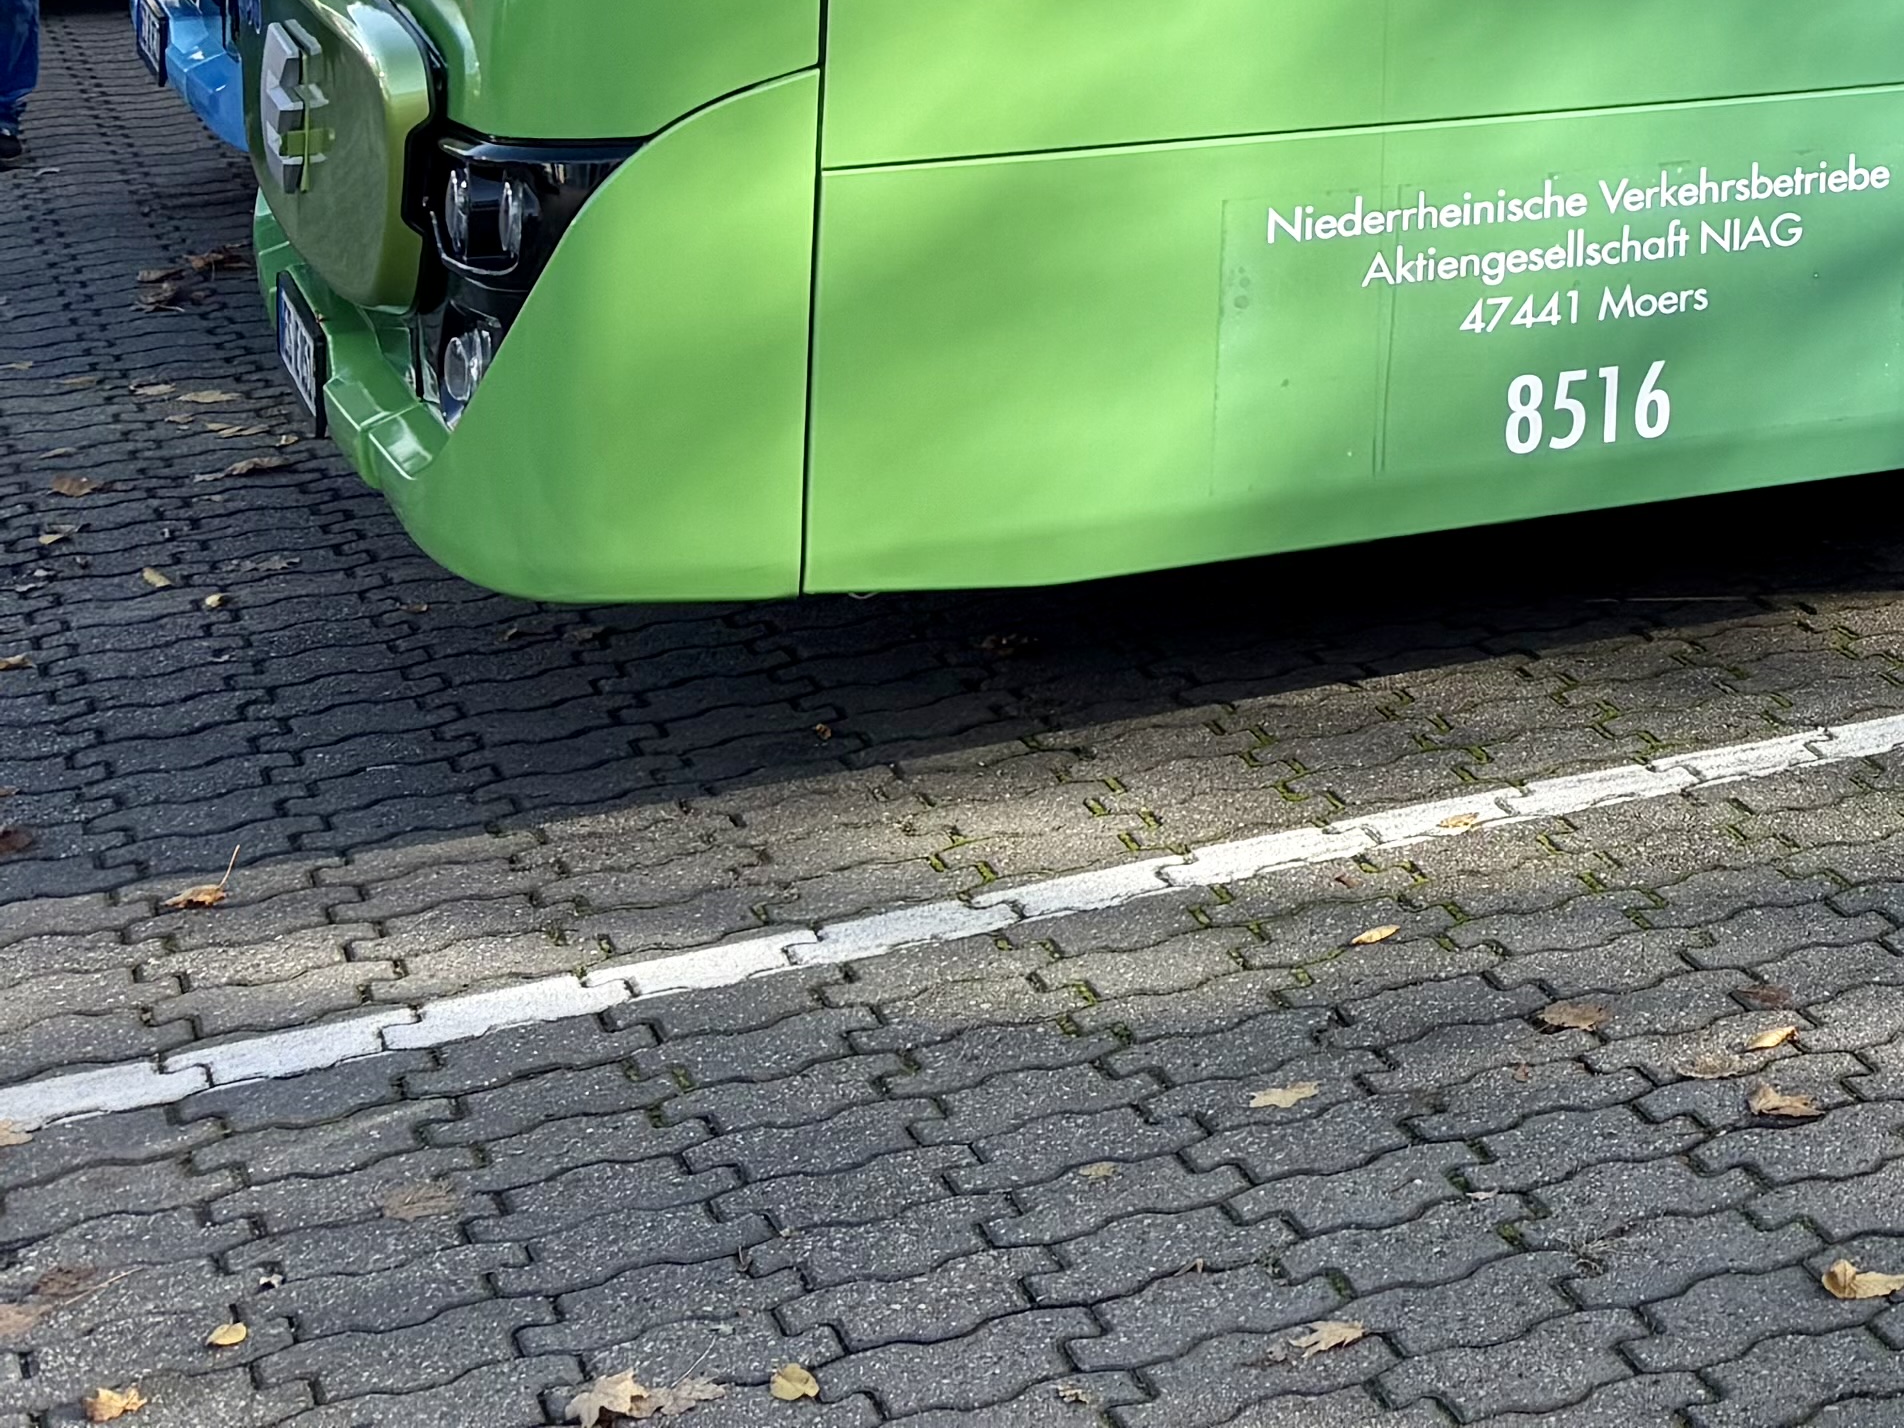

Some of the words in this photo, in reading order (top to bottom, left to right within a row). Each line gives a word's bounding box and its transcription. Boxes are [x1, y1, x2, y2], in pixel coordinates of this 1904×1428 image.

[1266, 179, 1588, 244] Niederrheinische
[1599, 154, 1891, 214] Verkehrsbetriebe
[1361, 219, 1689, 288] Aktiengesellschaft
[1700, 212, 1803, 254] NIAG
[1459, 289, 1581, 333] 47441
[1598, 284, 1709, 322] Moers
[1505, 360, 1671, 455] 8516
